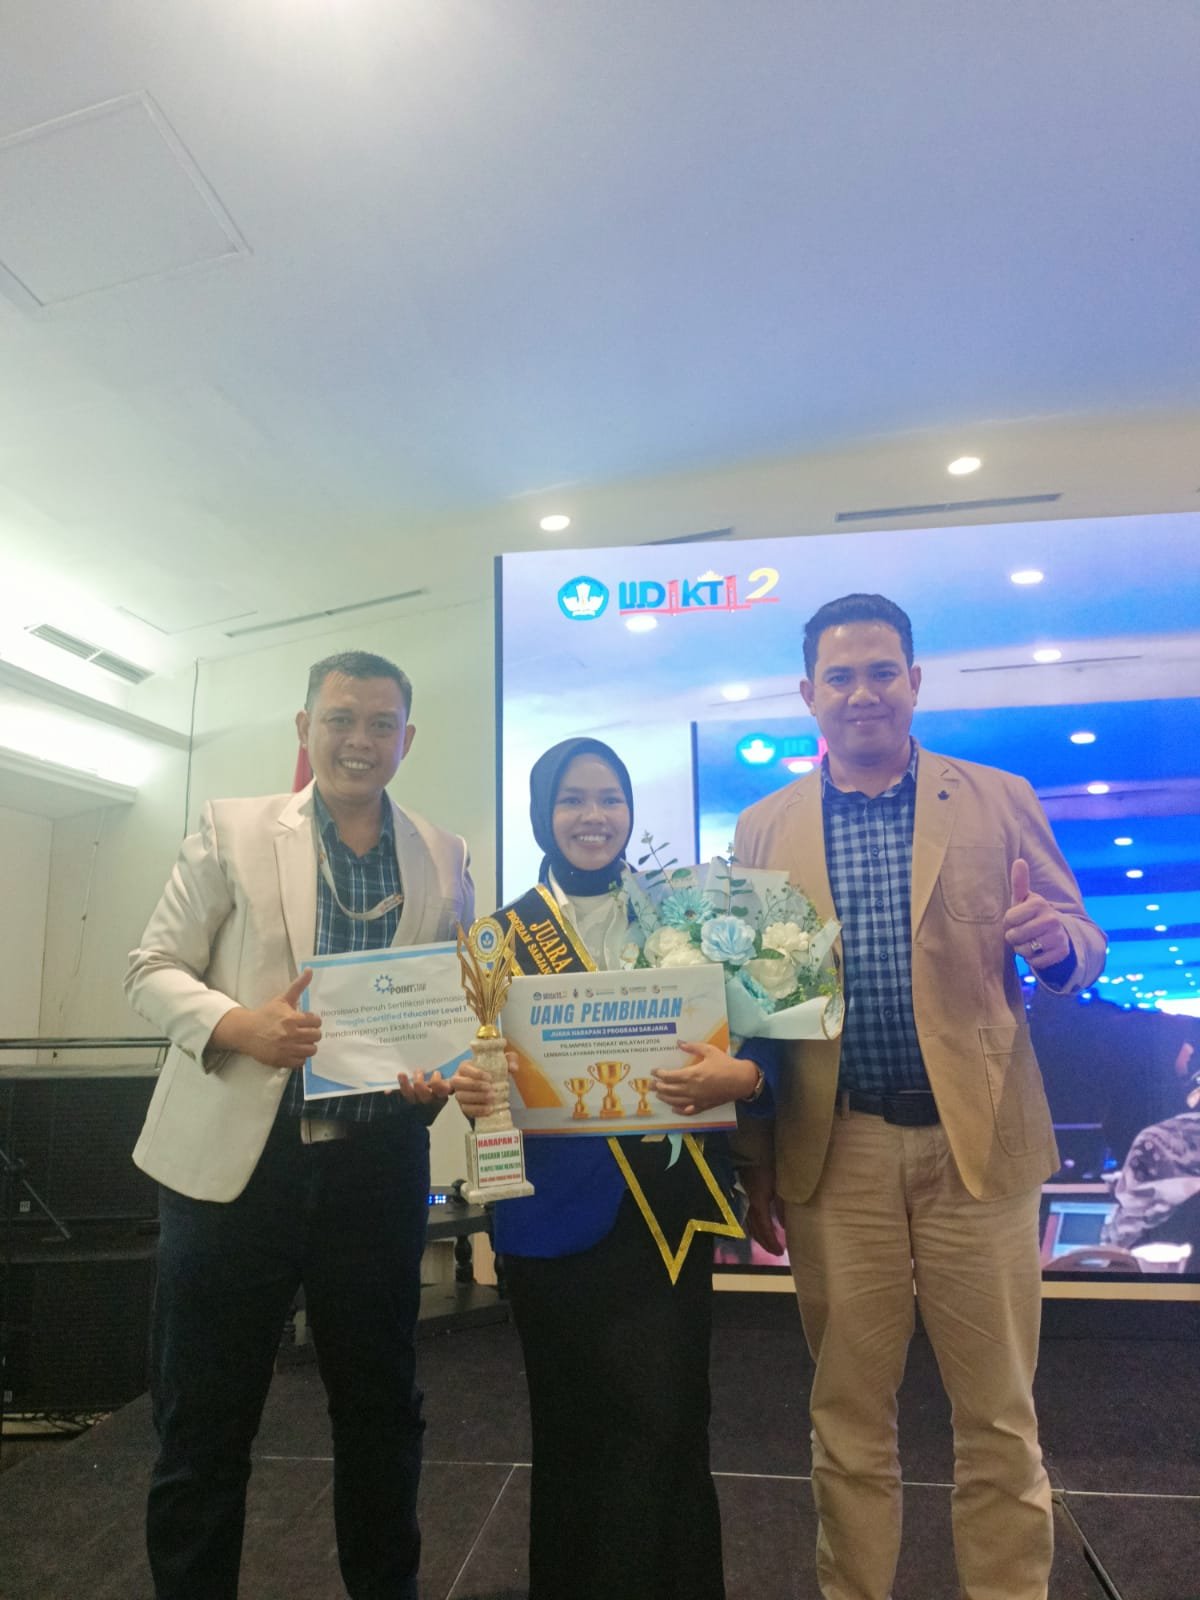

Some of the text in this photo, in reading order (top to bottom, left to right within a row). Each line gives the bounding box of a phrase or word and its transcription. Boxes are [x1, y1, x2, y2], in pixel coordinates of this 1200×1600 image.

[746, 567, 780, 600] 2
[529, 919, 573, 973] JUARA
[528, 943, 553, 974] SARJAN
[360, 1004, 386, 1012] Penuh
[403, 1008, 439, 1018] Educator
[441, 1006, 462, 1014] Level
[530, 997, 683, 1026] UANG PEMBINAAN
[607, 1026, 639, 1035] PROGRAM
[639, 1024, 668, 1033] SARJANA
[478, 1137, 513, 1148] HARAPAN
